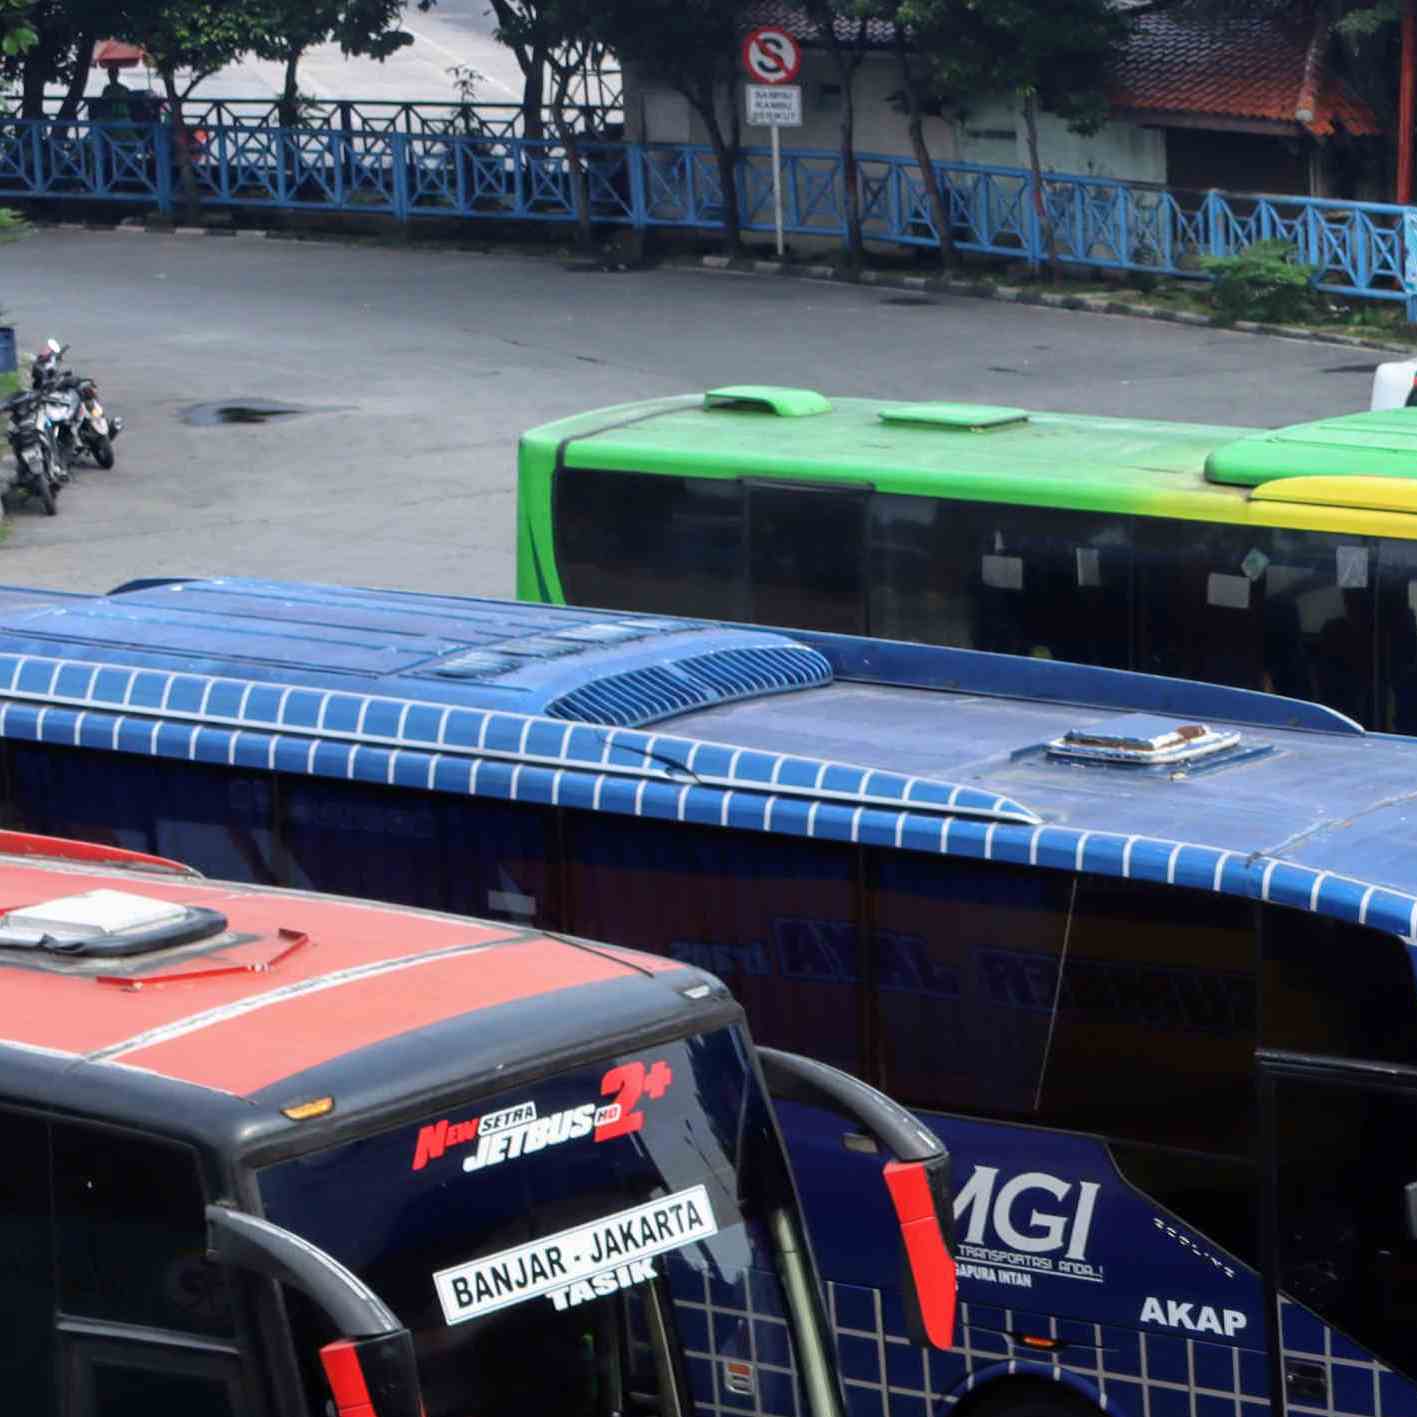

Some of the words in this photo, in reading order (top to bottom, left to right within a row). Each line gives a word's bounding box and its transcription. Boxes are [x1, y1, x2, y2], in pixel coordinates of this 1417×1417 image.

[462, 1103, 596, 1173] JETBUS
[481, 1104, 535, 1132] SETRA
[451, 1245, 566, 1309] BANJAR
[590, 1199, 704, 1264] JAKARTA
[958, 1244, 1052, 1270] TRANSPORTASI
[545, 1256, 657, 1311] TASIK
[998, 1271, 1032, 1288] INTAN
[1140, 1297, 1247, 1337] AKAP
